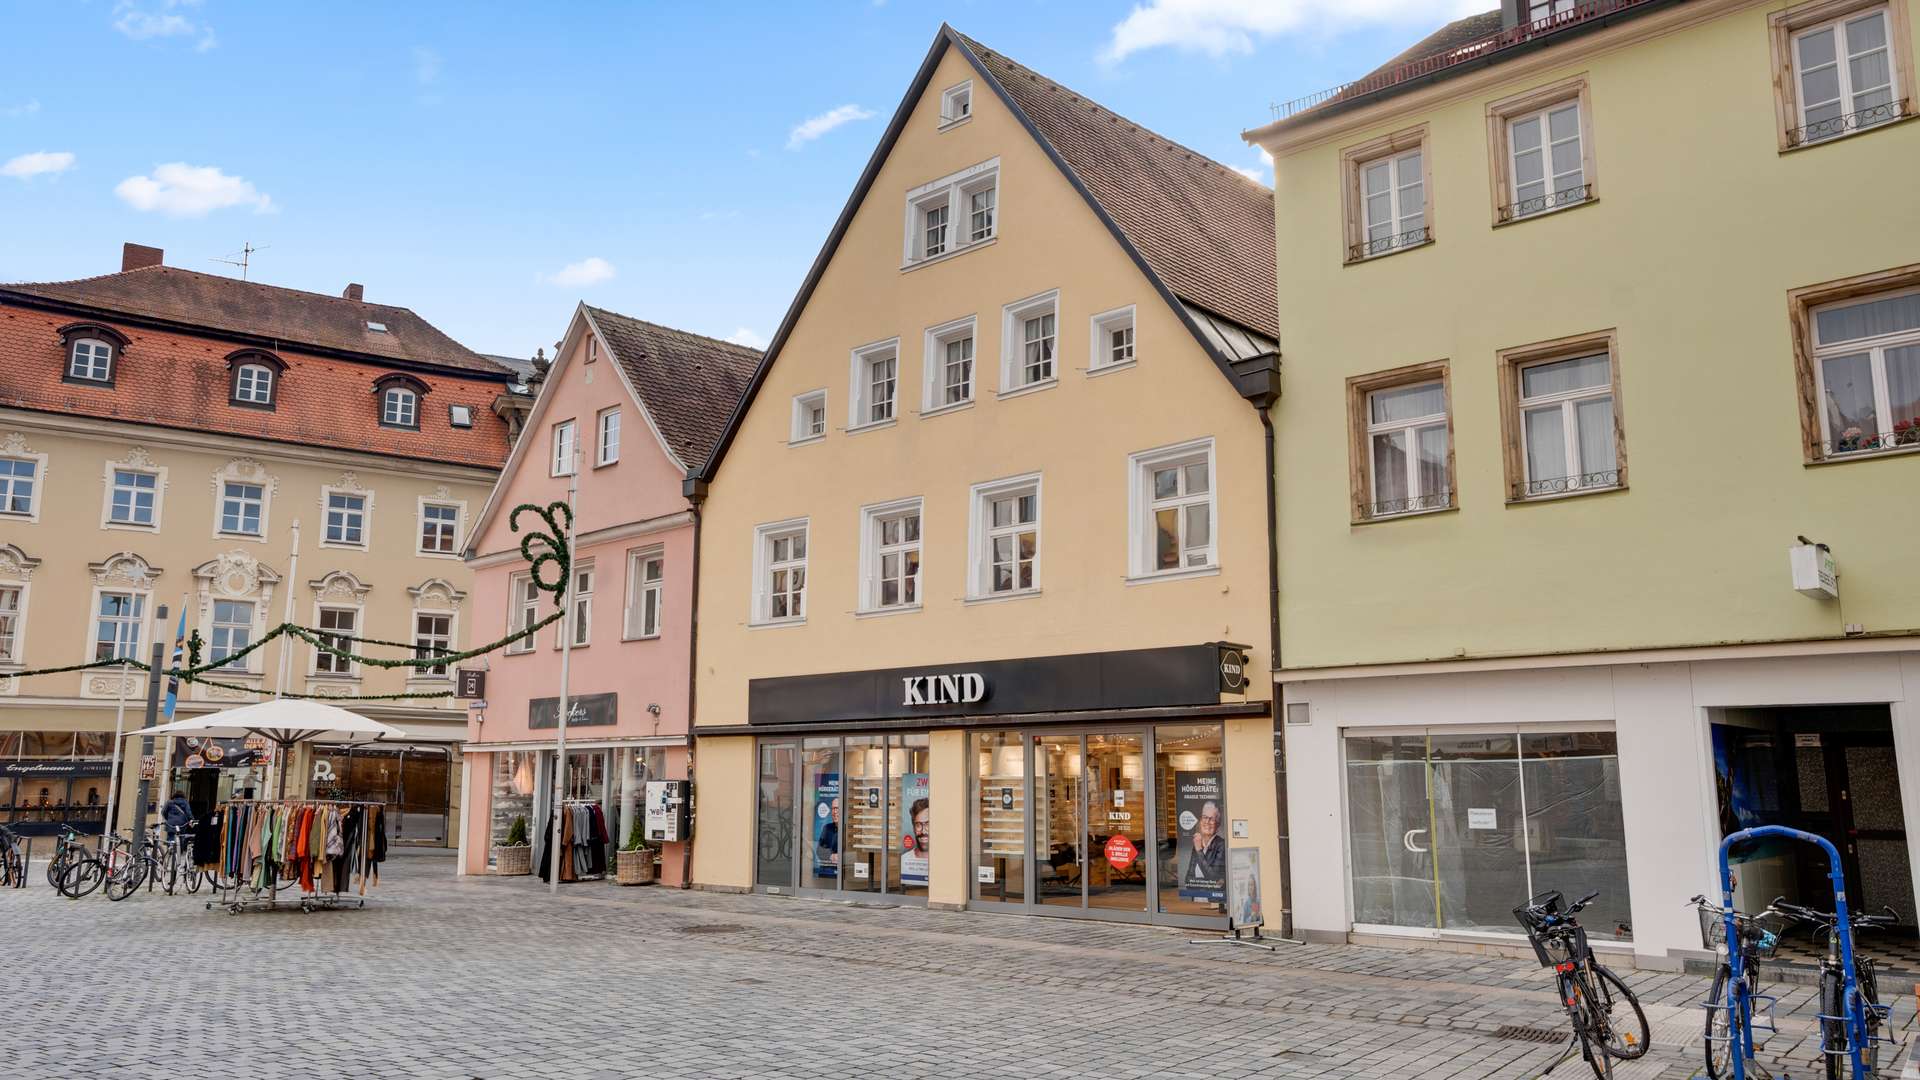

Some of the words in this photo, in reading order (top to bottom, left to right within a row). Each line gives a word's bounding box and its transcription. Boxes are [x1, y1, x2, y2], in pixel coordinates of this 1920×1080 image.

[1224, 663, 1240, 674] KIND
[902, 673, 985, 706] KIND
[1197, 777, 1217, 785] MEINE
[1108, 811, 1132, 820] KIND
